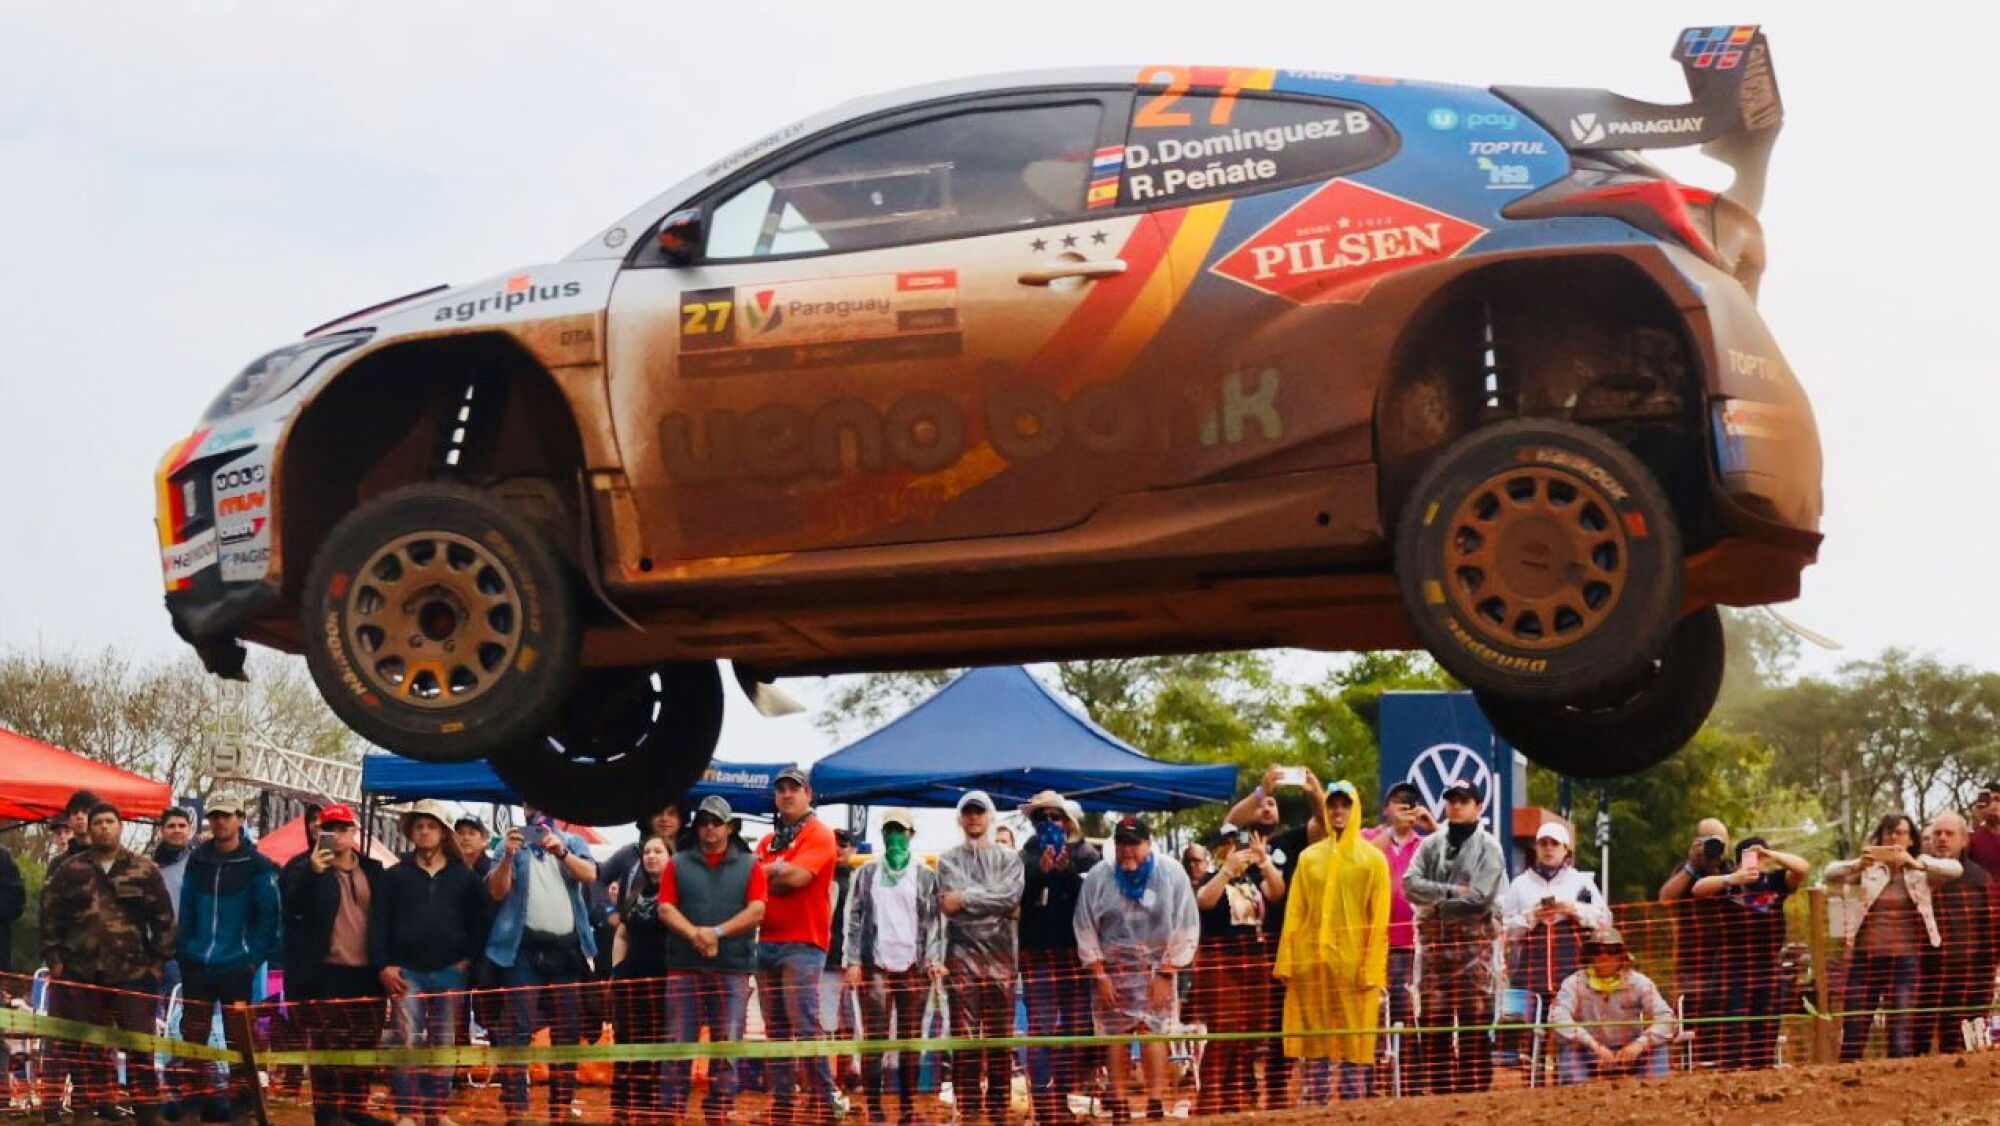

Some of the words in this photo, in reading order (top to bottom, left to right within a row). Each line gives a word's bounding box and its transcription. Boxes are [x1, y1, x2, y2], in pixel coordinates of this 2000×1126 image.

[1132, 65, 1249, 127] 27
[1126, 117, 1341, 169] D.Dominguez
[1344, 111, 1370, 134] B
[1467, 113, 1518, 130] pay
[1607, 117, 1704, 134] PARAGUAY
[1468, 141, 1547, 155] TOPTUL
[1129, 158, 1277, 201] R.Peñate
[1251, 222, 1442, 280] PILSEN
[434, 281, 582, 322] agriplus
[682, 301, 732, 335] 27
[789, 296, 890, 317] Paraguay
